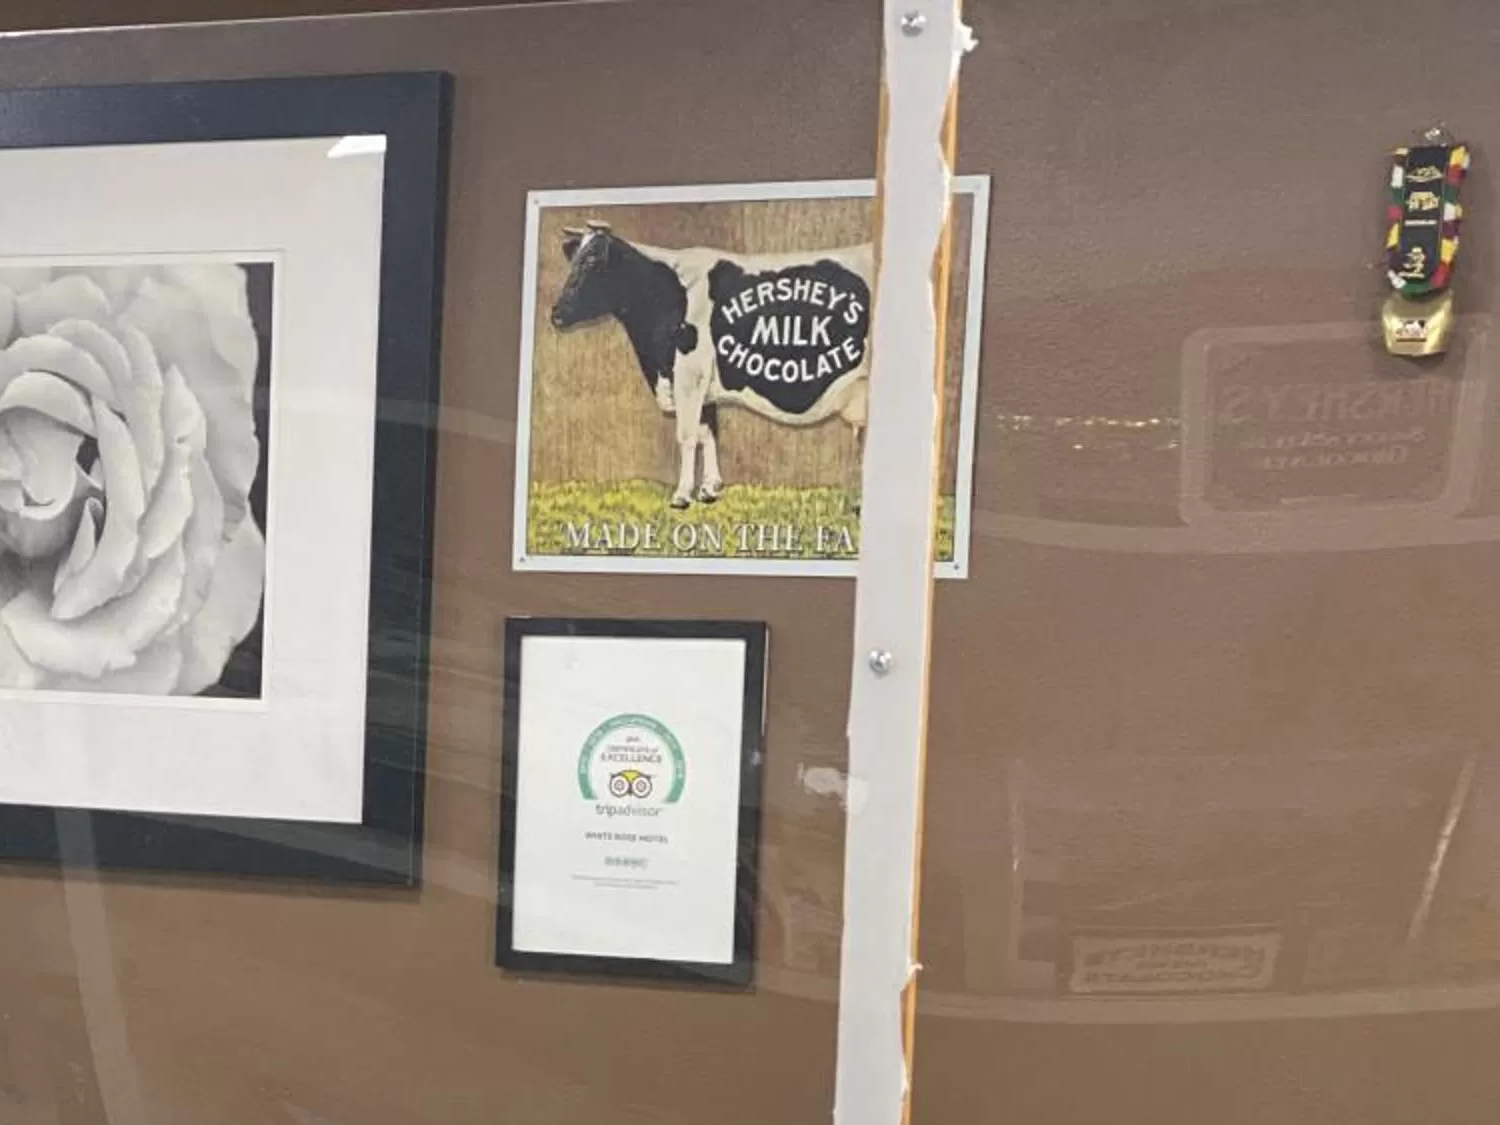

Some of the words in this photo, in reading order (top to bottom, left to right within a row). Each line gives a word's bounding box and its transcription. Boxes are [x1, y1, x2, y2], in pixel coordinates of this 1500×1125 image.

[721, 277, 865, 325] HERSHEY'S
[751, 315, 833, 346] MILK
[718, 334, 861, 383] CHOCOLATE
[673, 523, 722, 551] ON
[736, 524, 801, 551] THE
[816, 524, 856, 551] FA
